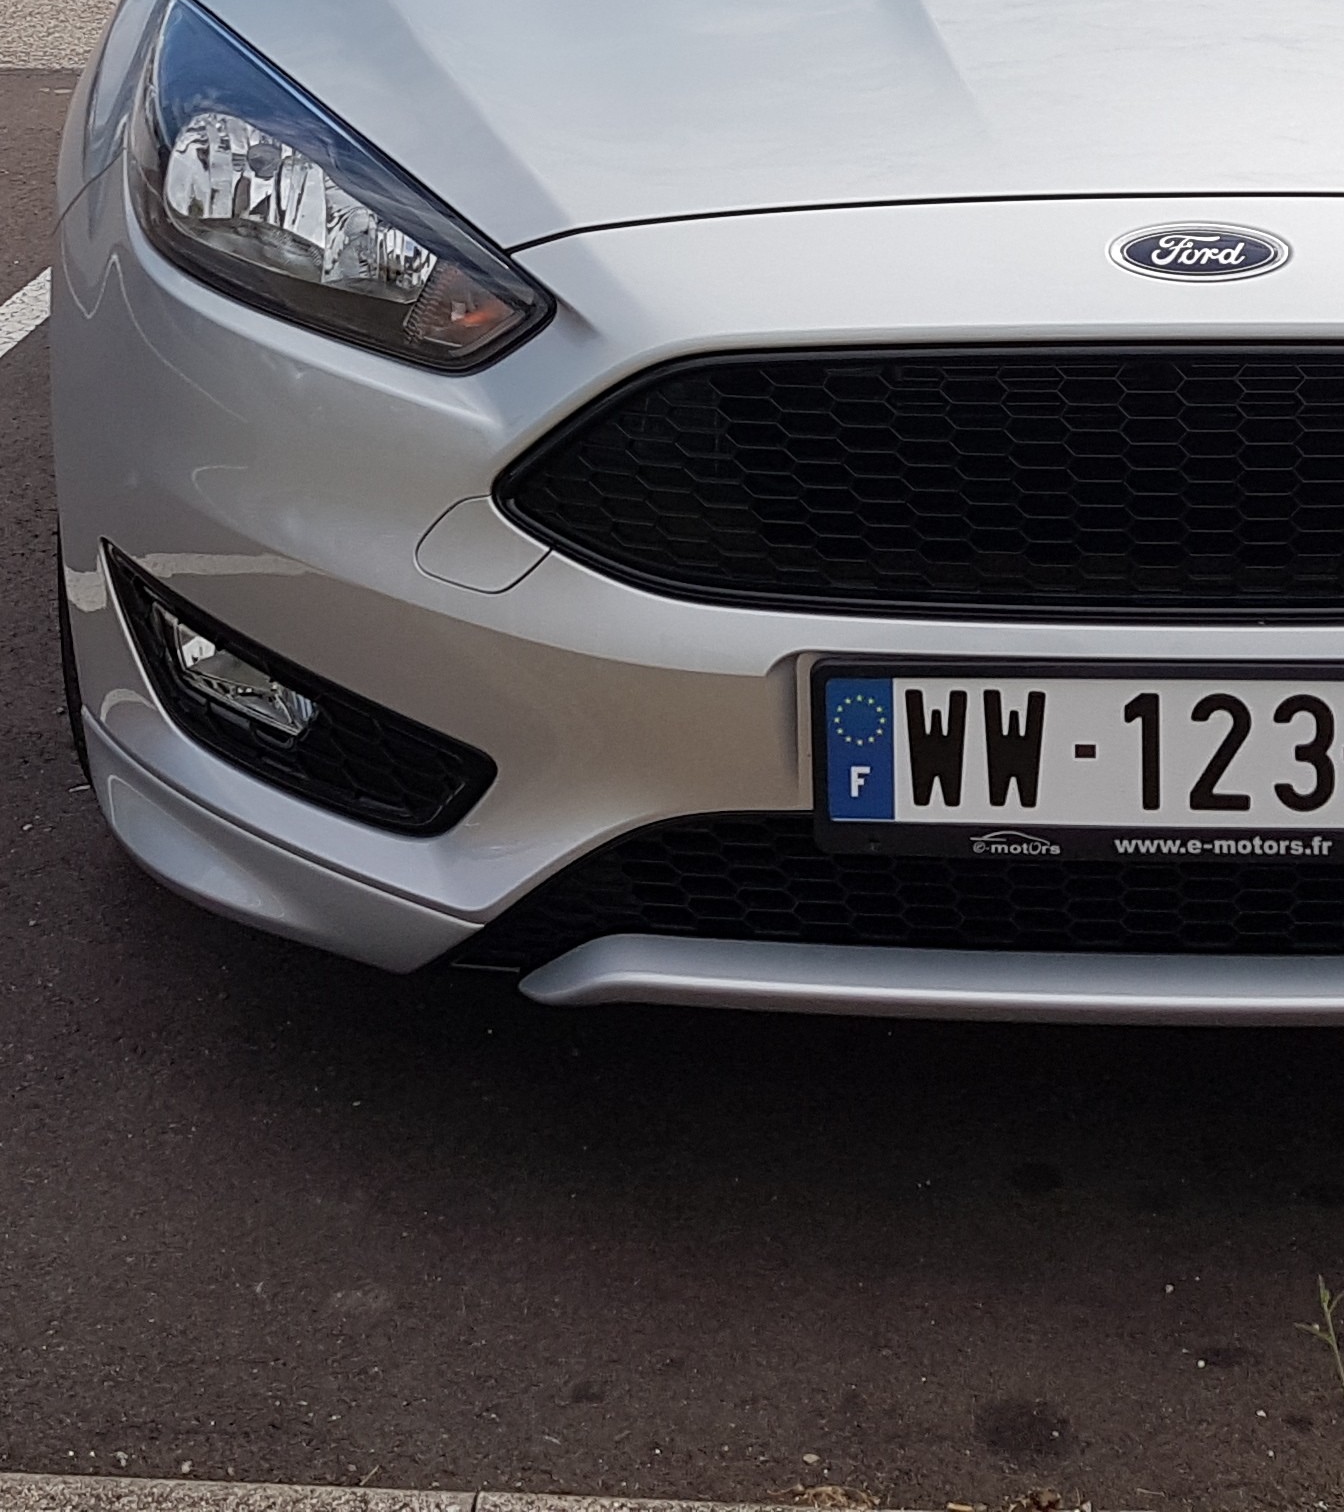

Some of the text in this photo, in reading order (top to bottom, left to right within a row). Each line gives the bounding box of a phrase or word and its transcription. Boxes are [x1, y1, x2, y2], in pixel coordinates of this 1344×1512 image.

[1151, 234, 1246, 266] Ford
[850, 765, 871, 798] F
[1114, 836, 1333, 856] www.e-motors.fr
